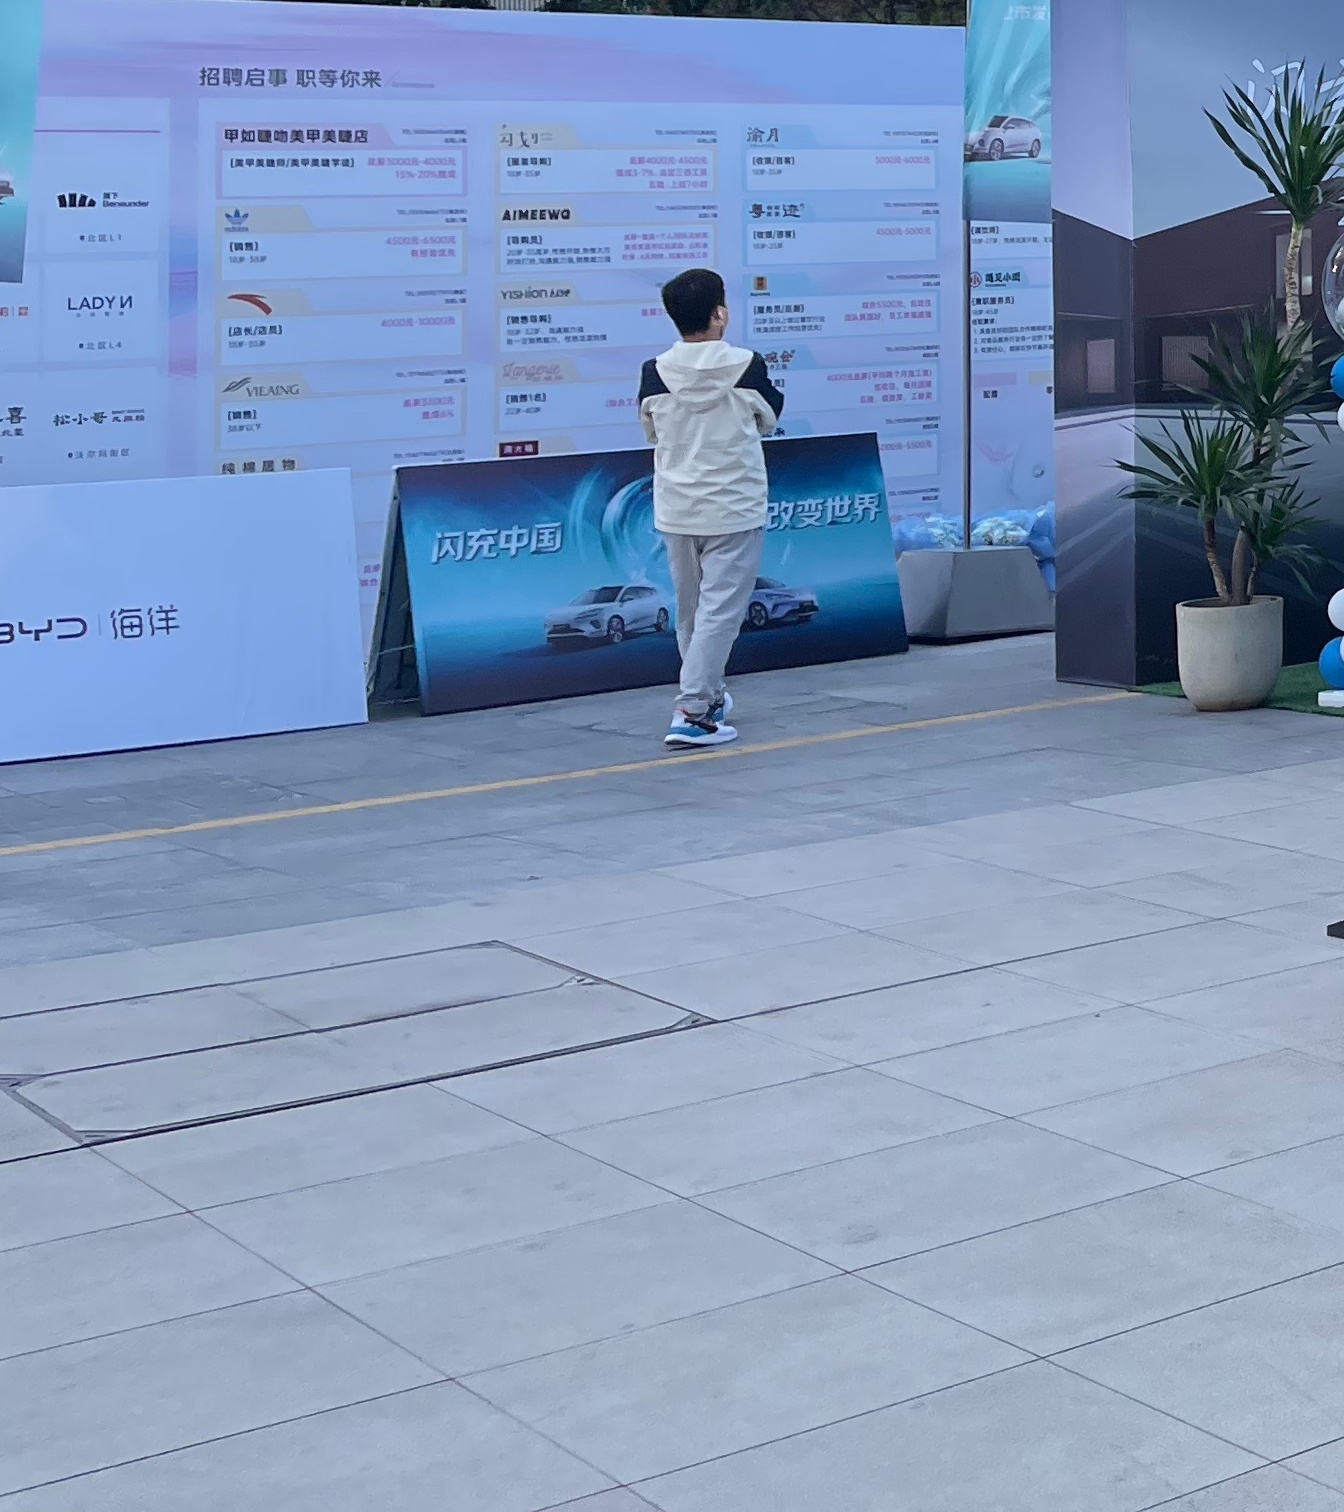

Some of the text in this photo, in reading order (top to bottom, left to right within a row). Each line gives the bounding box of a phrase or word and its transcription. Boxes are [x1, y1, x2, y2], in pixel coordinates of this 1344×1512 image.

[199, 67, 382, 88] 招聘启事 职等你来
[431, 521, 563, 566] 闪充中国
[110, 604, 180, 640] 海洋
